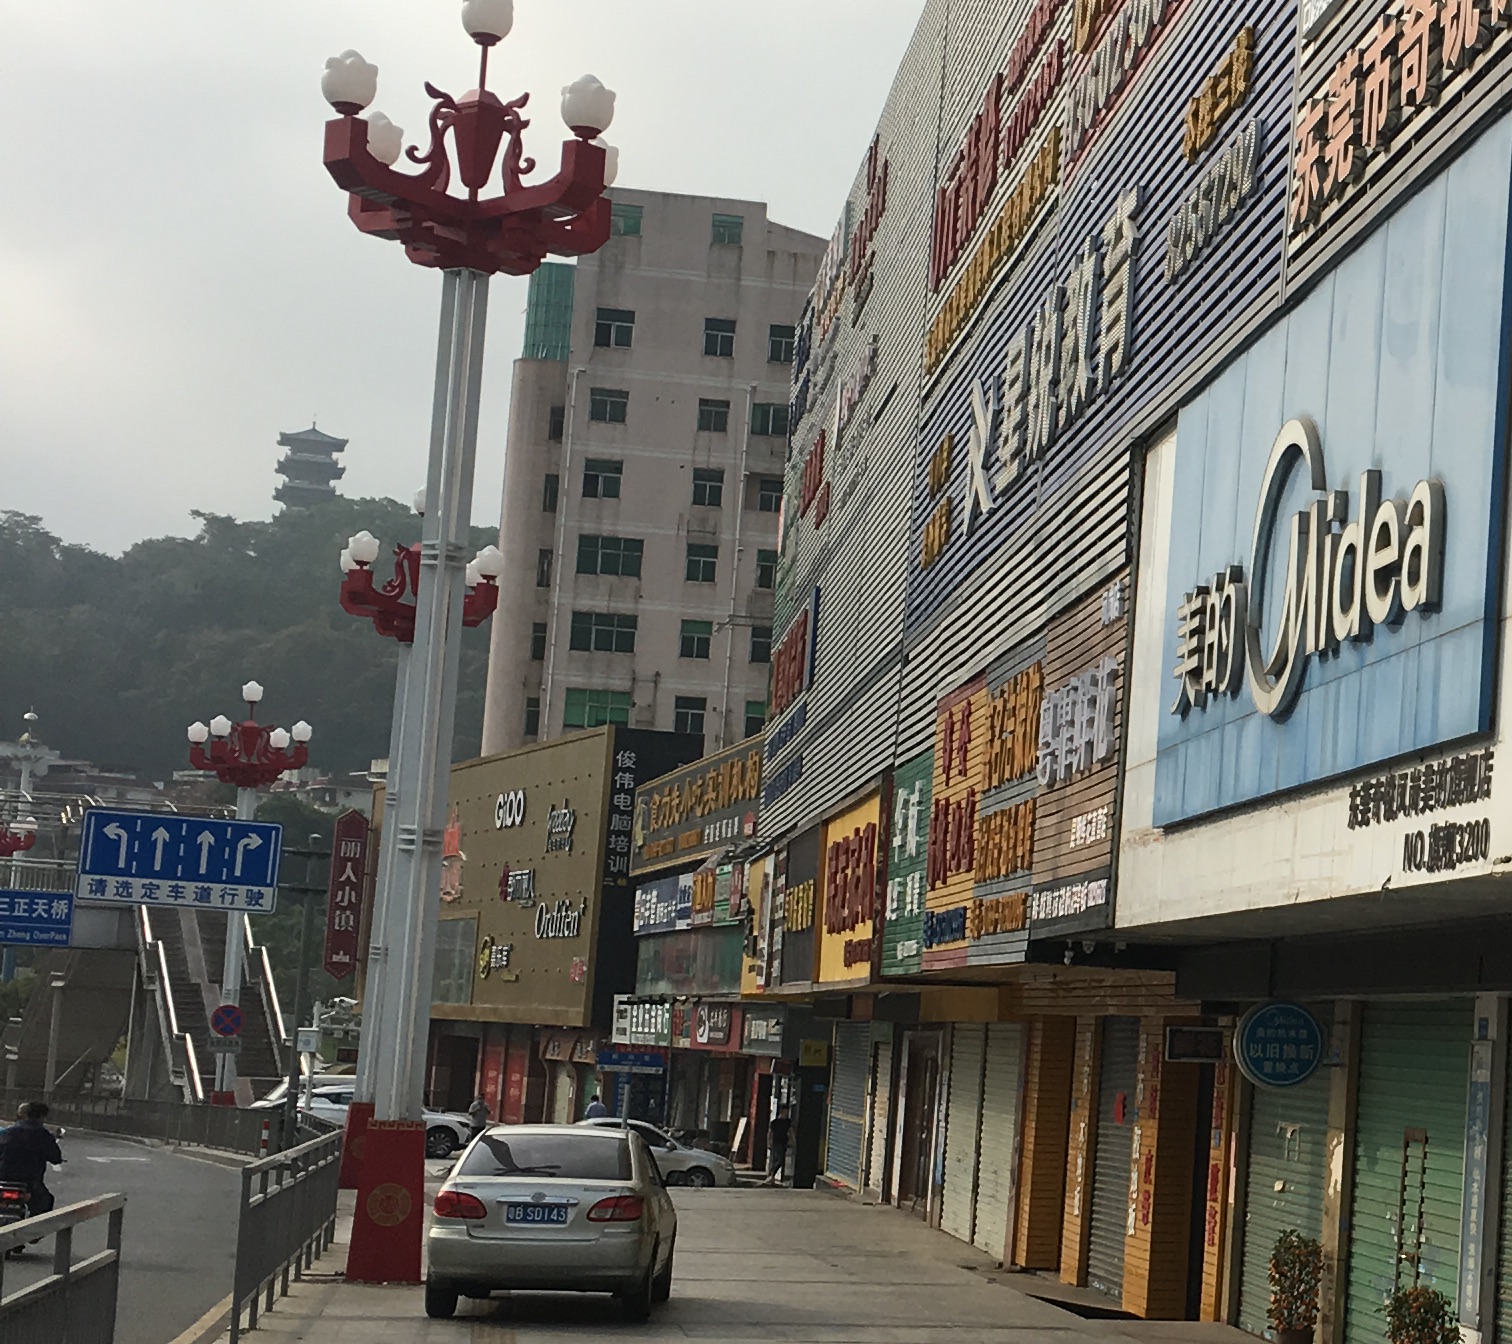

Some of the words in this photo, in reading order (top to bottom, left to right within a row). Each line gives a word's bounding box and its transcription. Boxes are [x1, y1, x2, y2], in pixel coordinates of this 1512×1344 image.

[1172, 566, 1246, 716] 美的
[1246, 418, 1446, 719] Midea
[608, 750, 636, 874] 俊伟电脑培训
[87, 877, 265, 907] 请选定车道行驶
[1249, 1043, 1314, 1060] 以旧换新
